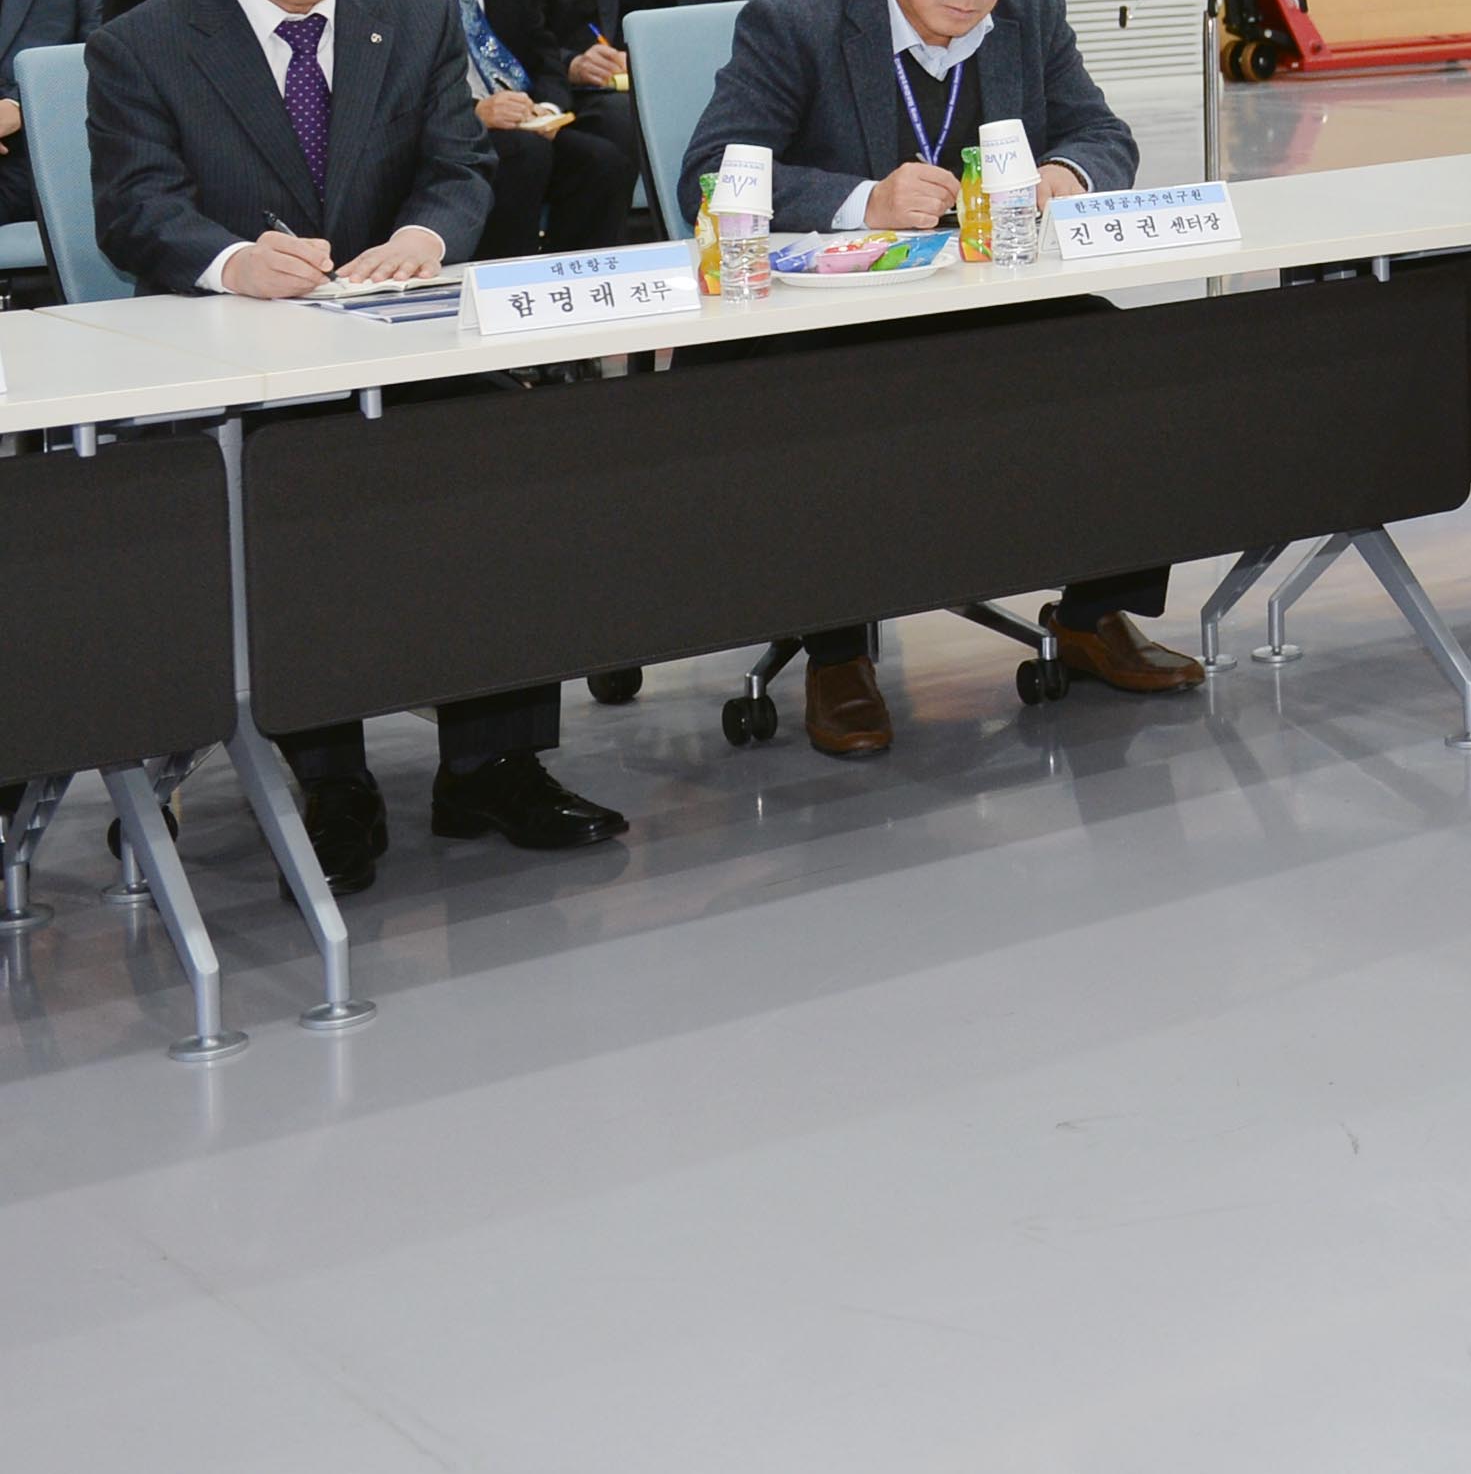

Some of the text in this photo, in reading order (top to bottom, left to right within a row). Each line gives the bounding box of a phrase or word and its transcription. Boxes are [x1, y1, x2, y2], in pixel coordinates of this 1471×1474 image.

[1074, 189, 1203, 214] 한국항공우주연구원
[1170, 212, 1221, 235] 센터장
[550, 256, 620, 276] 대한항공
[630, 280, 672, 303] 전무
